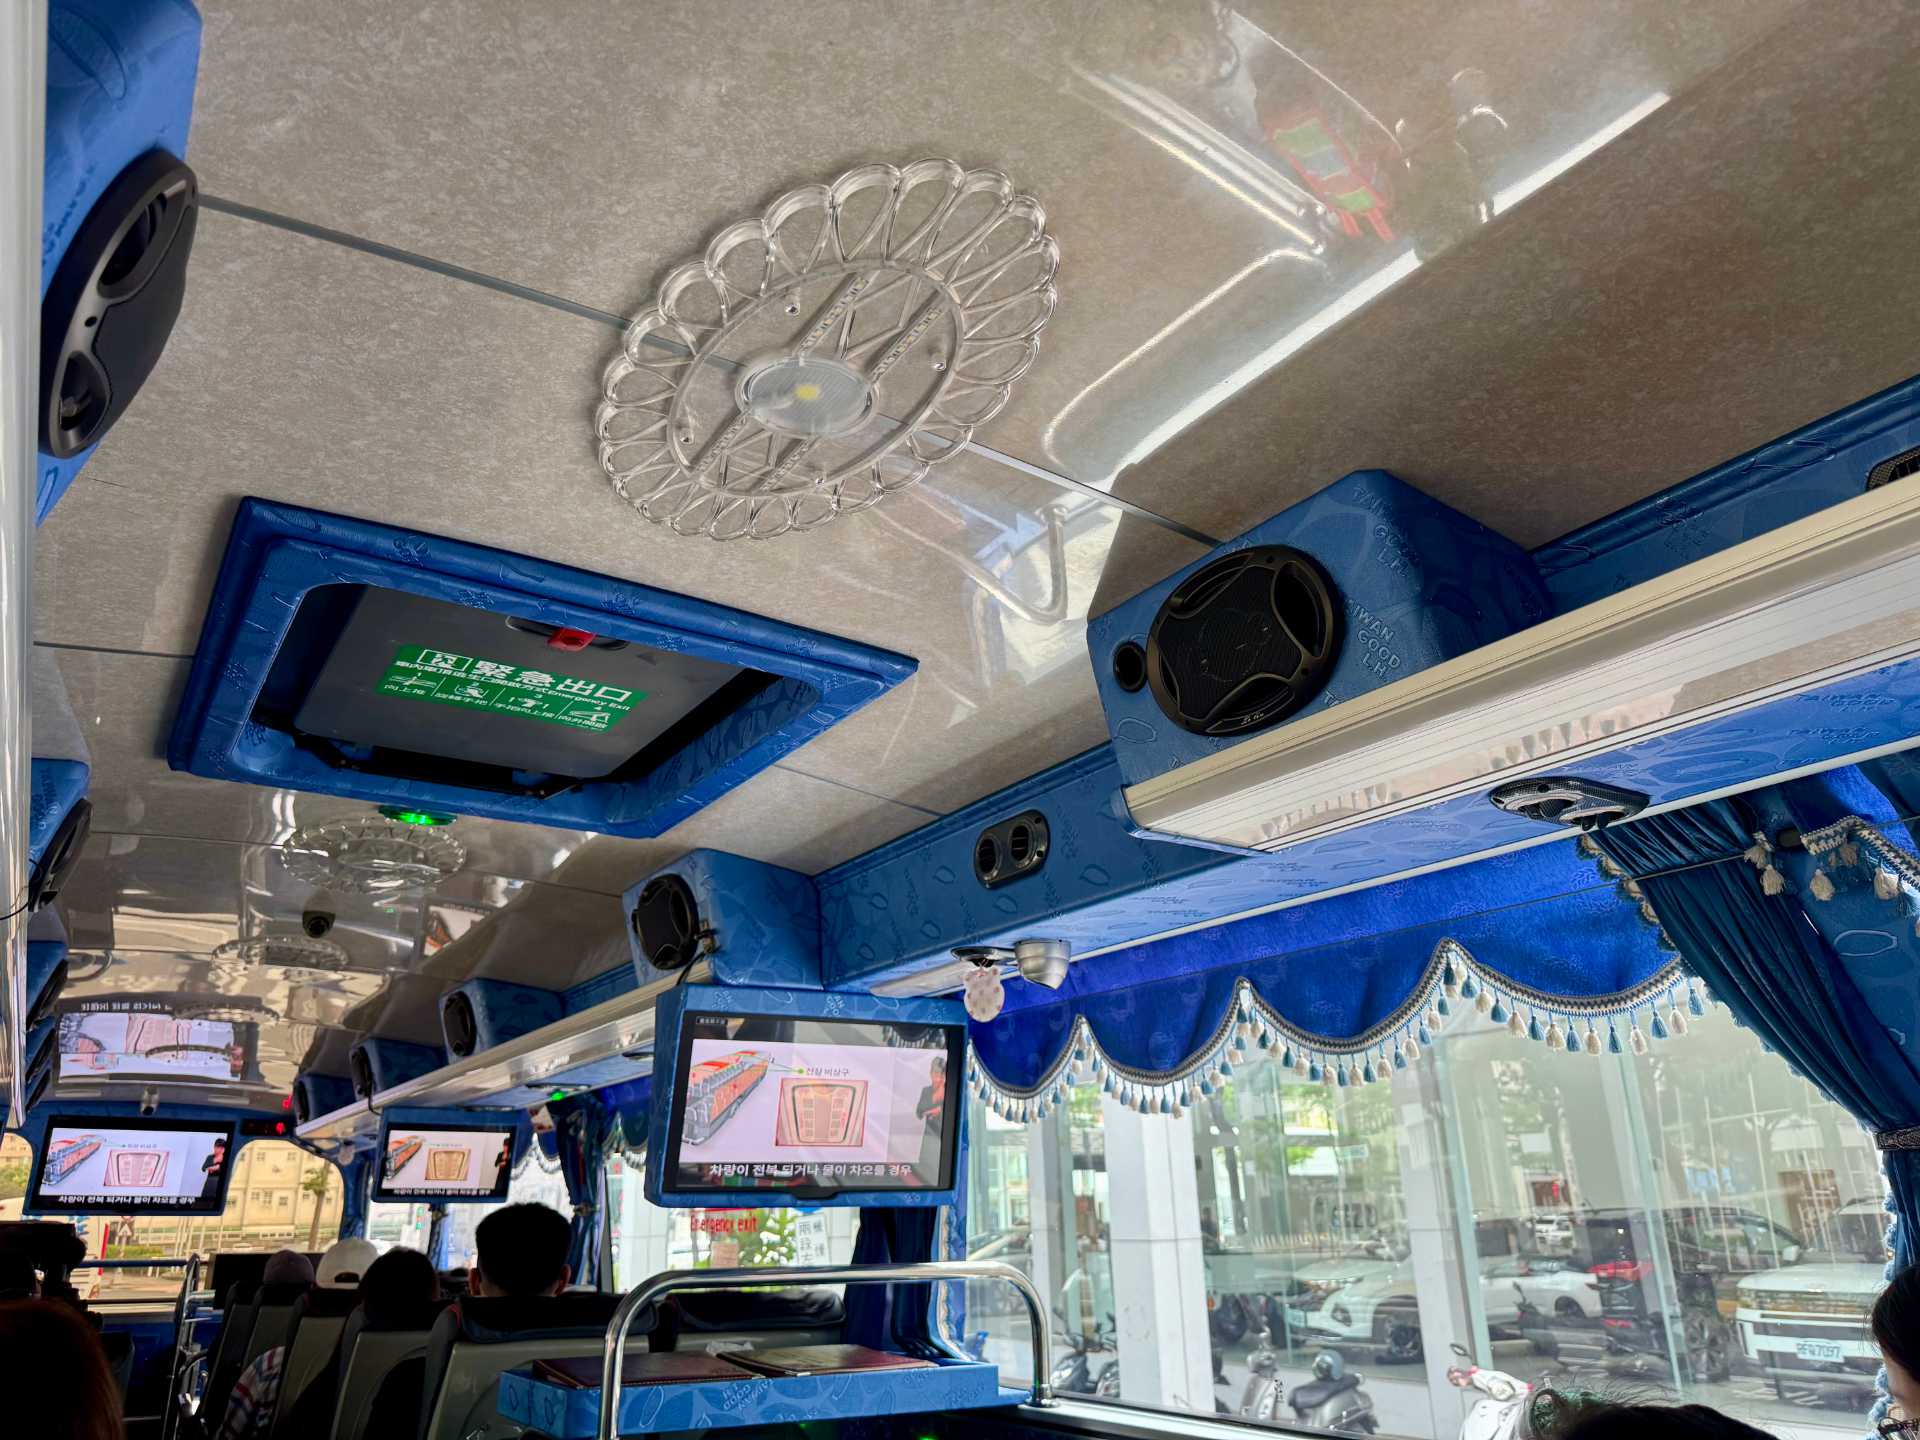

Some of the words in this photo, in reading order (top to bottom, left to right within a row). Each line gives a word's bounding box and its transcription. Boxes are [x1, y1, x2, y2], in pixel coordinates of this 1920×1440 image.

[471, 660, 632, 702] 緊急出口
[710, 1163, 749, 1177] 차량이
[752, 1163, 777, 1177] 전복
[782, 1163, 819, 1177] 되거나
[822, 1164, 847, 1177] 물이
[850, 1164, 885, 1177] 차오를
[888, 1165, 912, 1177] 경우
[737, 1216, 758, 1233] exit
